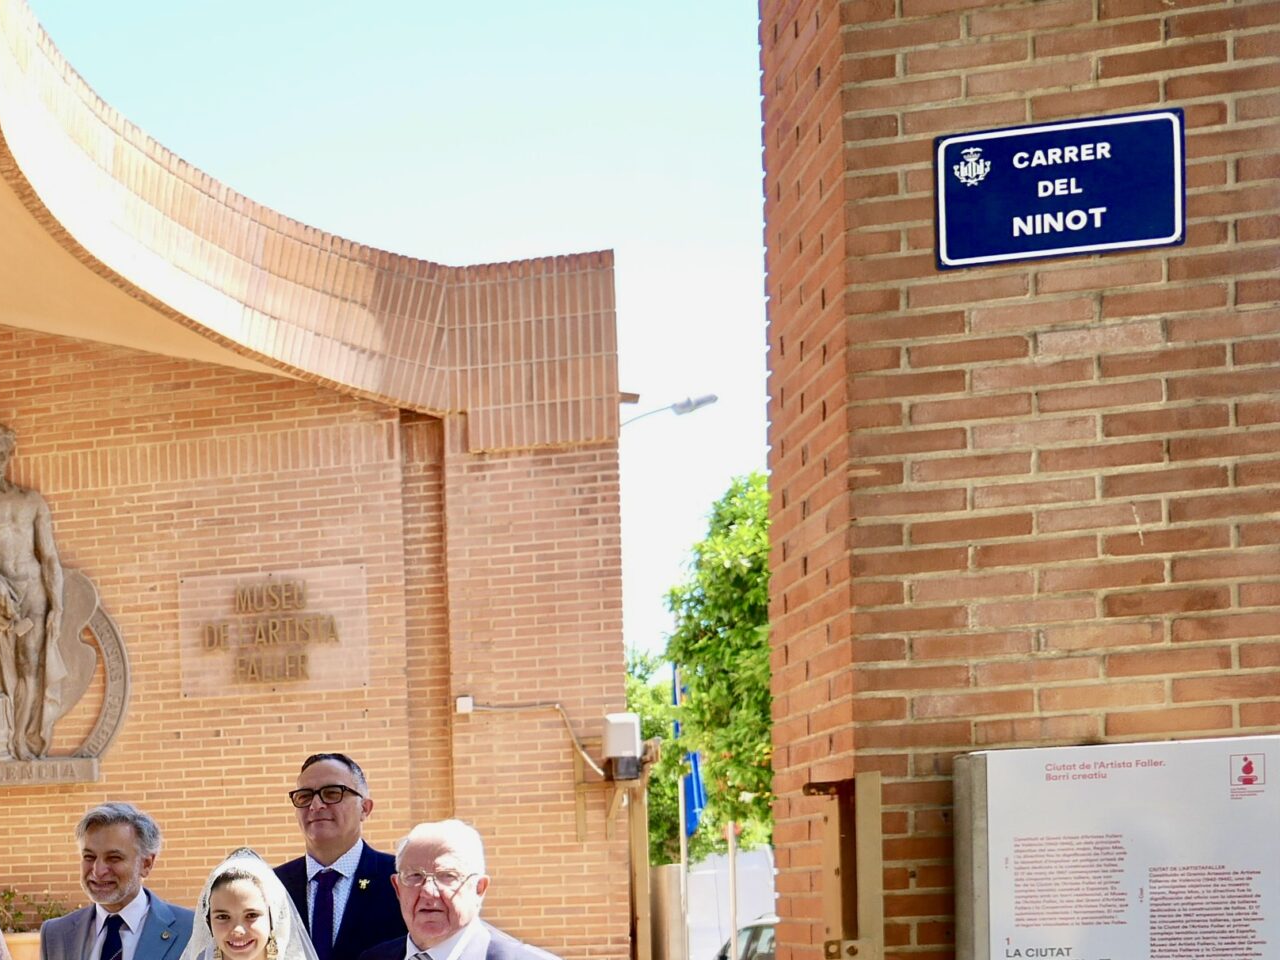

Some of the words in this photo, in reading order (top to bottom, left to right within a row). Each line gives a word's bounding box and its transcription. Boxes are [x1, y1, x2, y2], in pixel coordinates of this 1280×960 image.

[1013, 142, 1112, 169] CARRER
[1038, 178, 1082, 198] DEL
[1013, 207, 1107, 236] NINOT
[235, 580, 307, 613] MUSEU
[203, 623, 230, 650] DE
[239, 615, 340, 647] L'ARTISTA
[235, 654, 310, 683] FALLER
[1045, 762, 1076, 771] Ciutat
[1079, 761, 1091, 770] de
[1094, 760, 1133, 770] l'Artista
[1135, 759, 1166, 768] Faller.
[1045, 772, 1069, 782] Barri
[1071, 771, 1107, 780] creatiu
[1006, 937, 1010, 945] 1
[1006, 948, 1022, 958] LA
[1025, 947, 1072, 957] CIUTAT
